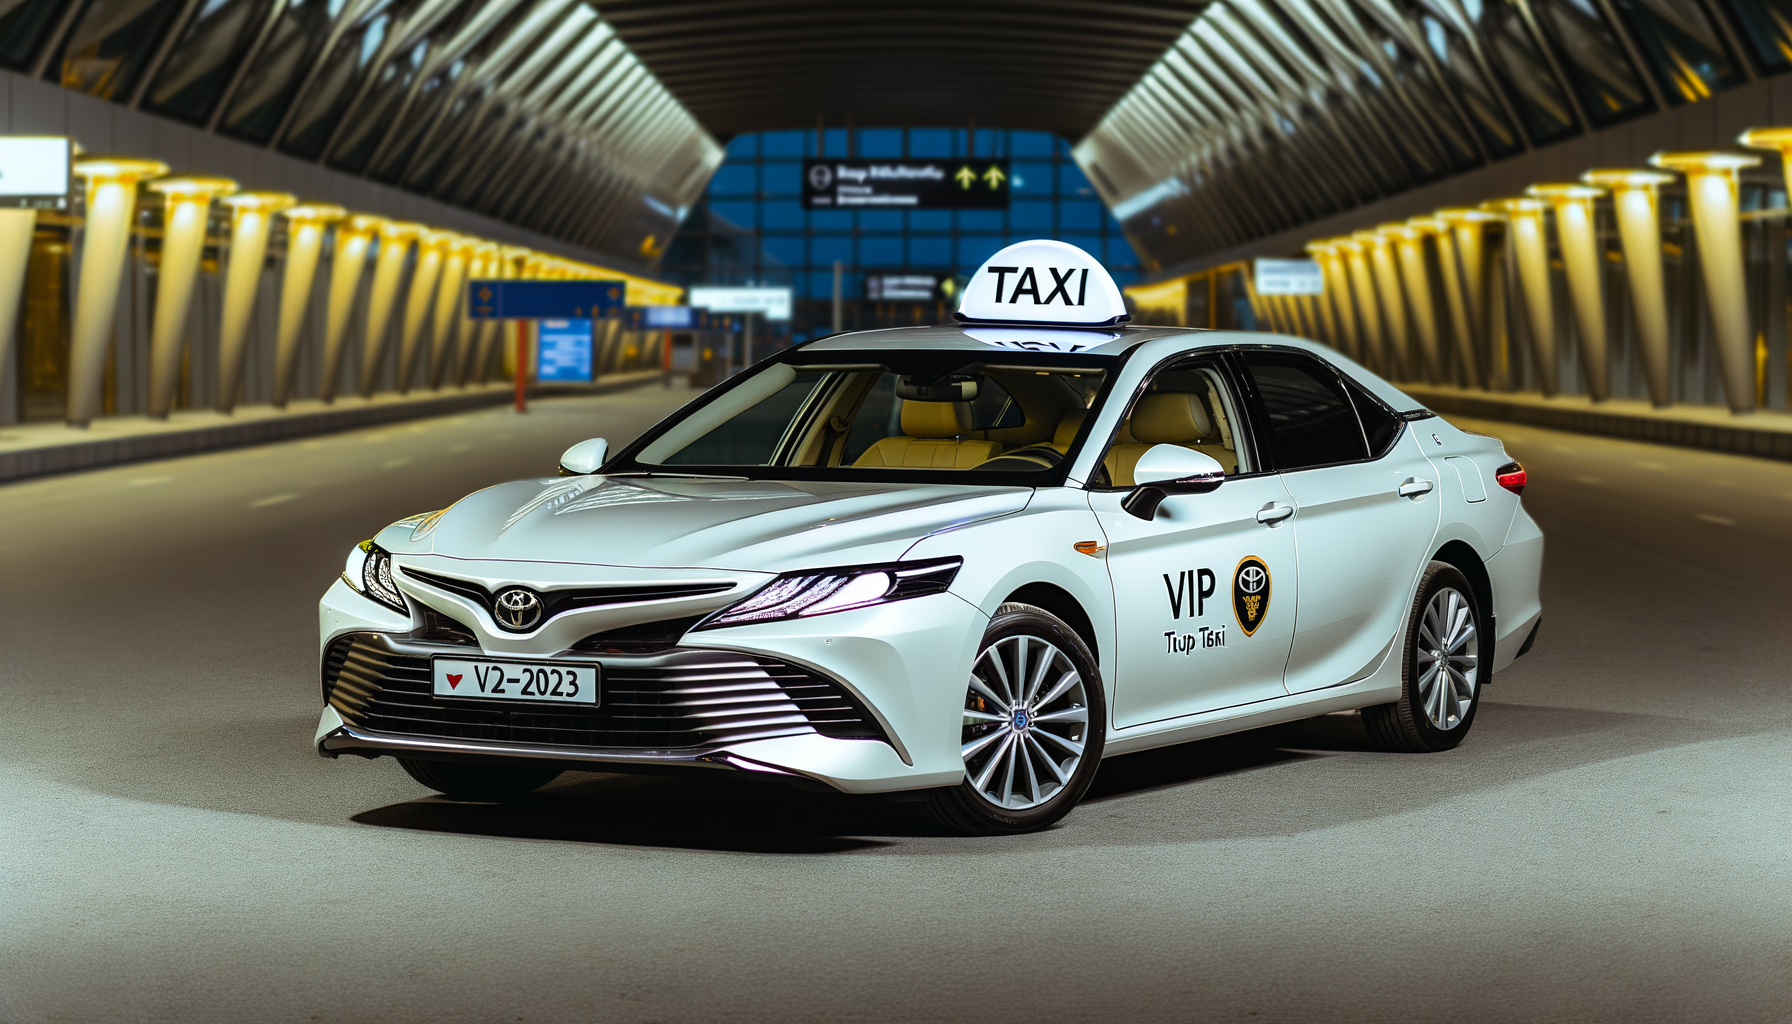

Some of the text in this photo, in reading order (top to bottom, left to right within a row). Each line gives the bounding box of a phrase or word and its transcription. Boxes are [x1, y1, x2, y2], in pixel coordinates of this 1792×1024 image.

[987, 266, 1089, 306] TAXI
[1163, 567, 1216, 620] VIP
[474, 665, 579, 697] V2-2023
